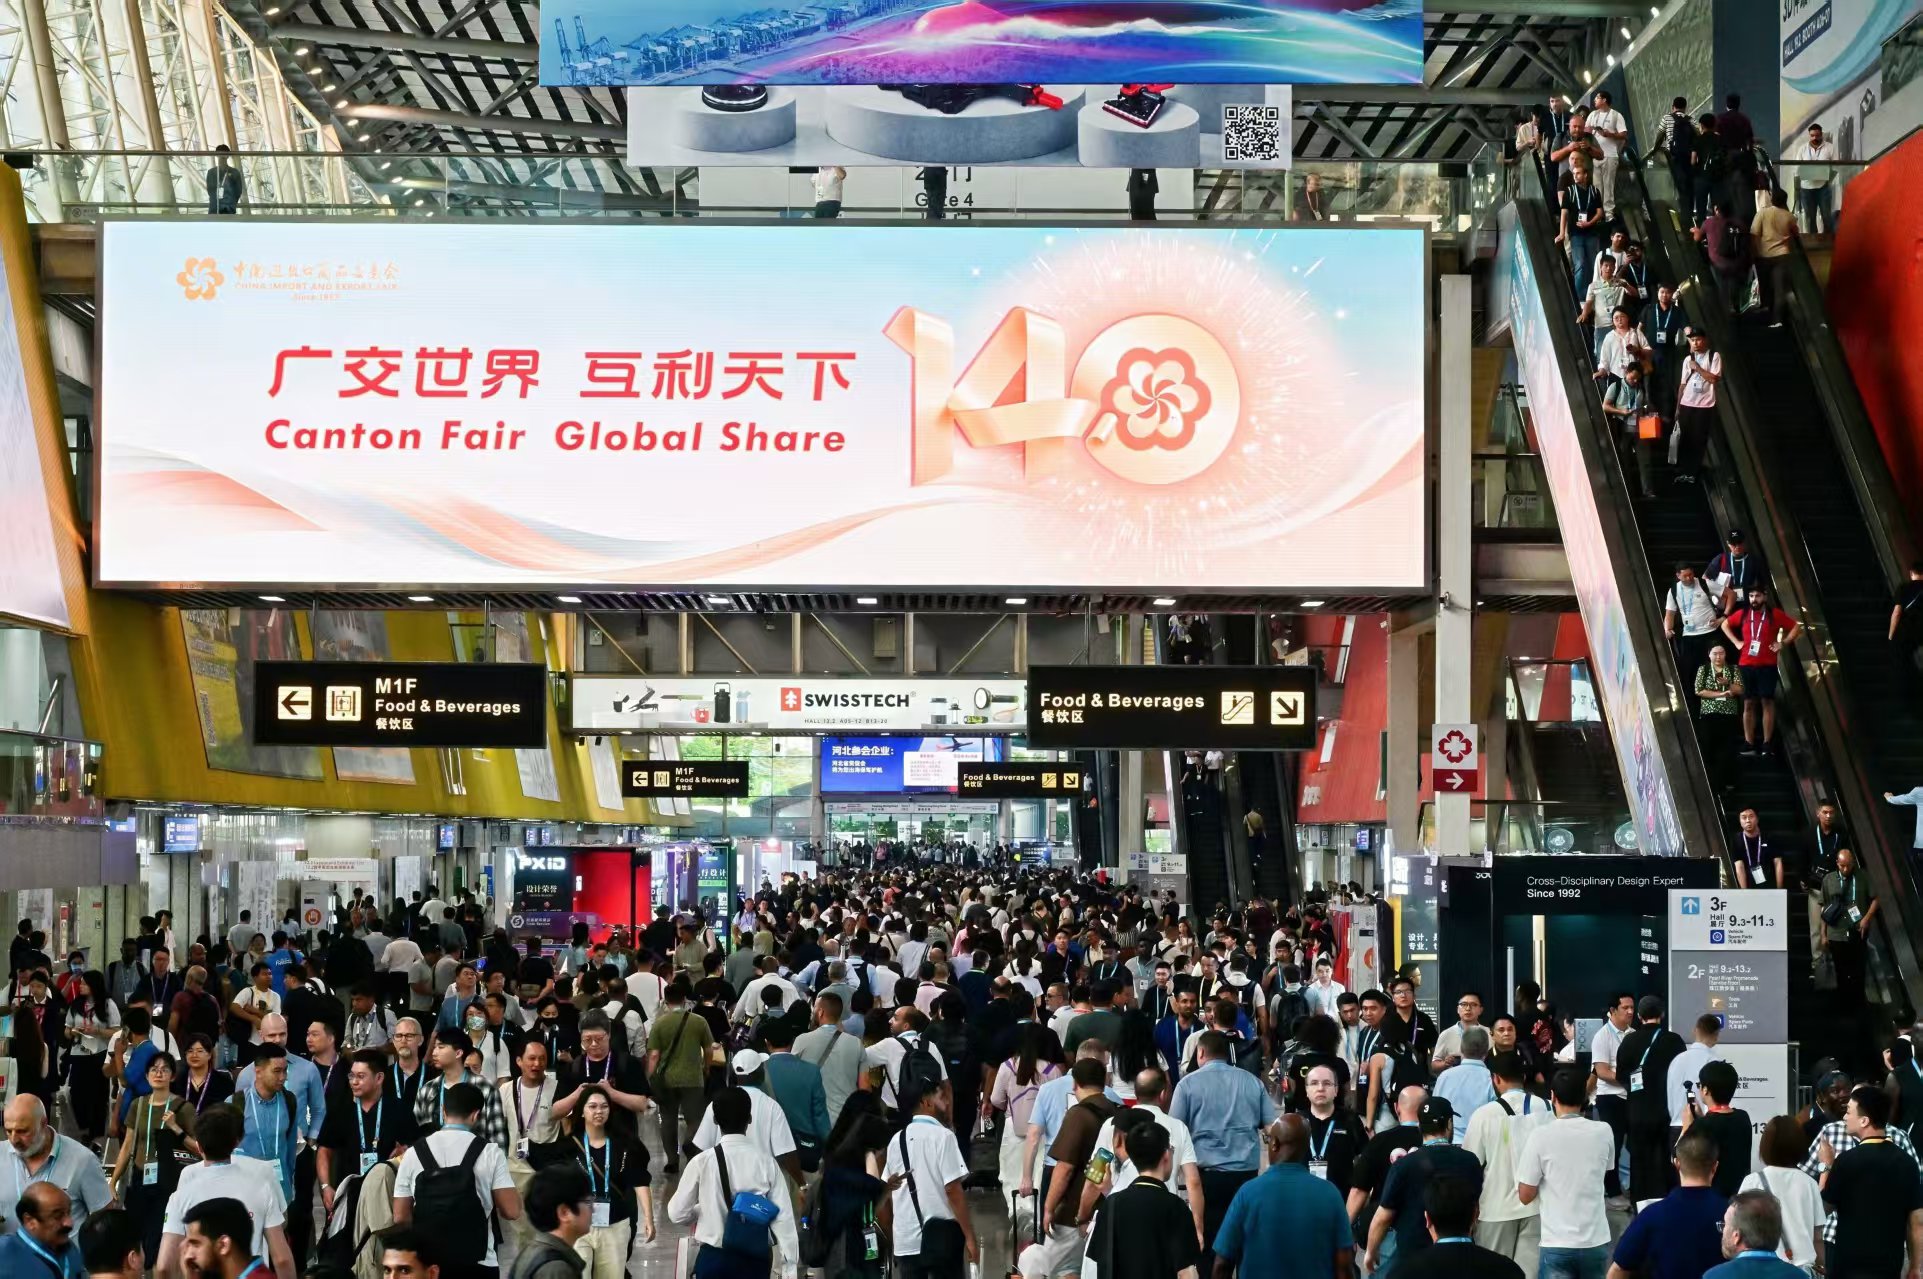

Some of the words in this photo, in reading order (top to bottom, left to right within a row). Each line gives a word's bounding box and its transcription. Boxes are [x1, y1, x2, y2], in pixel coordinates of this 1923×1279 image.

[964, 192, 973, 206] 4
[268, 346, 540, 398] 广交世界
[580, 349, 856, 401] 互利天下
[265, 419, 421, 449] Canton
[441, 420, 526, 450] Fair
[555, 421, 702, 450] Global
[720, 422, 845, 451] Share
[375, 678, 417, 694] M1F
[375, 699, 415, 712] Food
[420, 700, 431, 712] &
[435, 699, 520, 716] Beverages
[804, 694, 909, 708] SWISSTECH
[1040, 693, 1085, 707] Food
[1091, 693, 1103, 707] &
[1108, 693, 1205, 711] Beverages
[376, 718, 414, 730] 餐饮区
[1041, 710, 1084, 724] 餐饮区
[993, 774, 1035, 782] Beverages
[1617, 876, 1649, 887] Design
[1653, 876, 1684, 887] Expert
[1527, 889, 1554, 898] Since
[1558, 889, 1581, 898] 1992
[1710, 897, 1727, 911] 3F
[1729, 915, 1774, 927] 9.3-11.3
[1688, 964, 1705, 979] 2F
